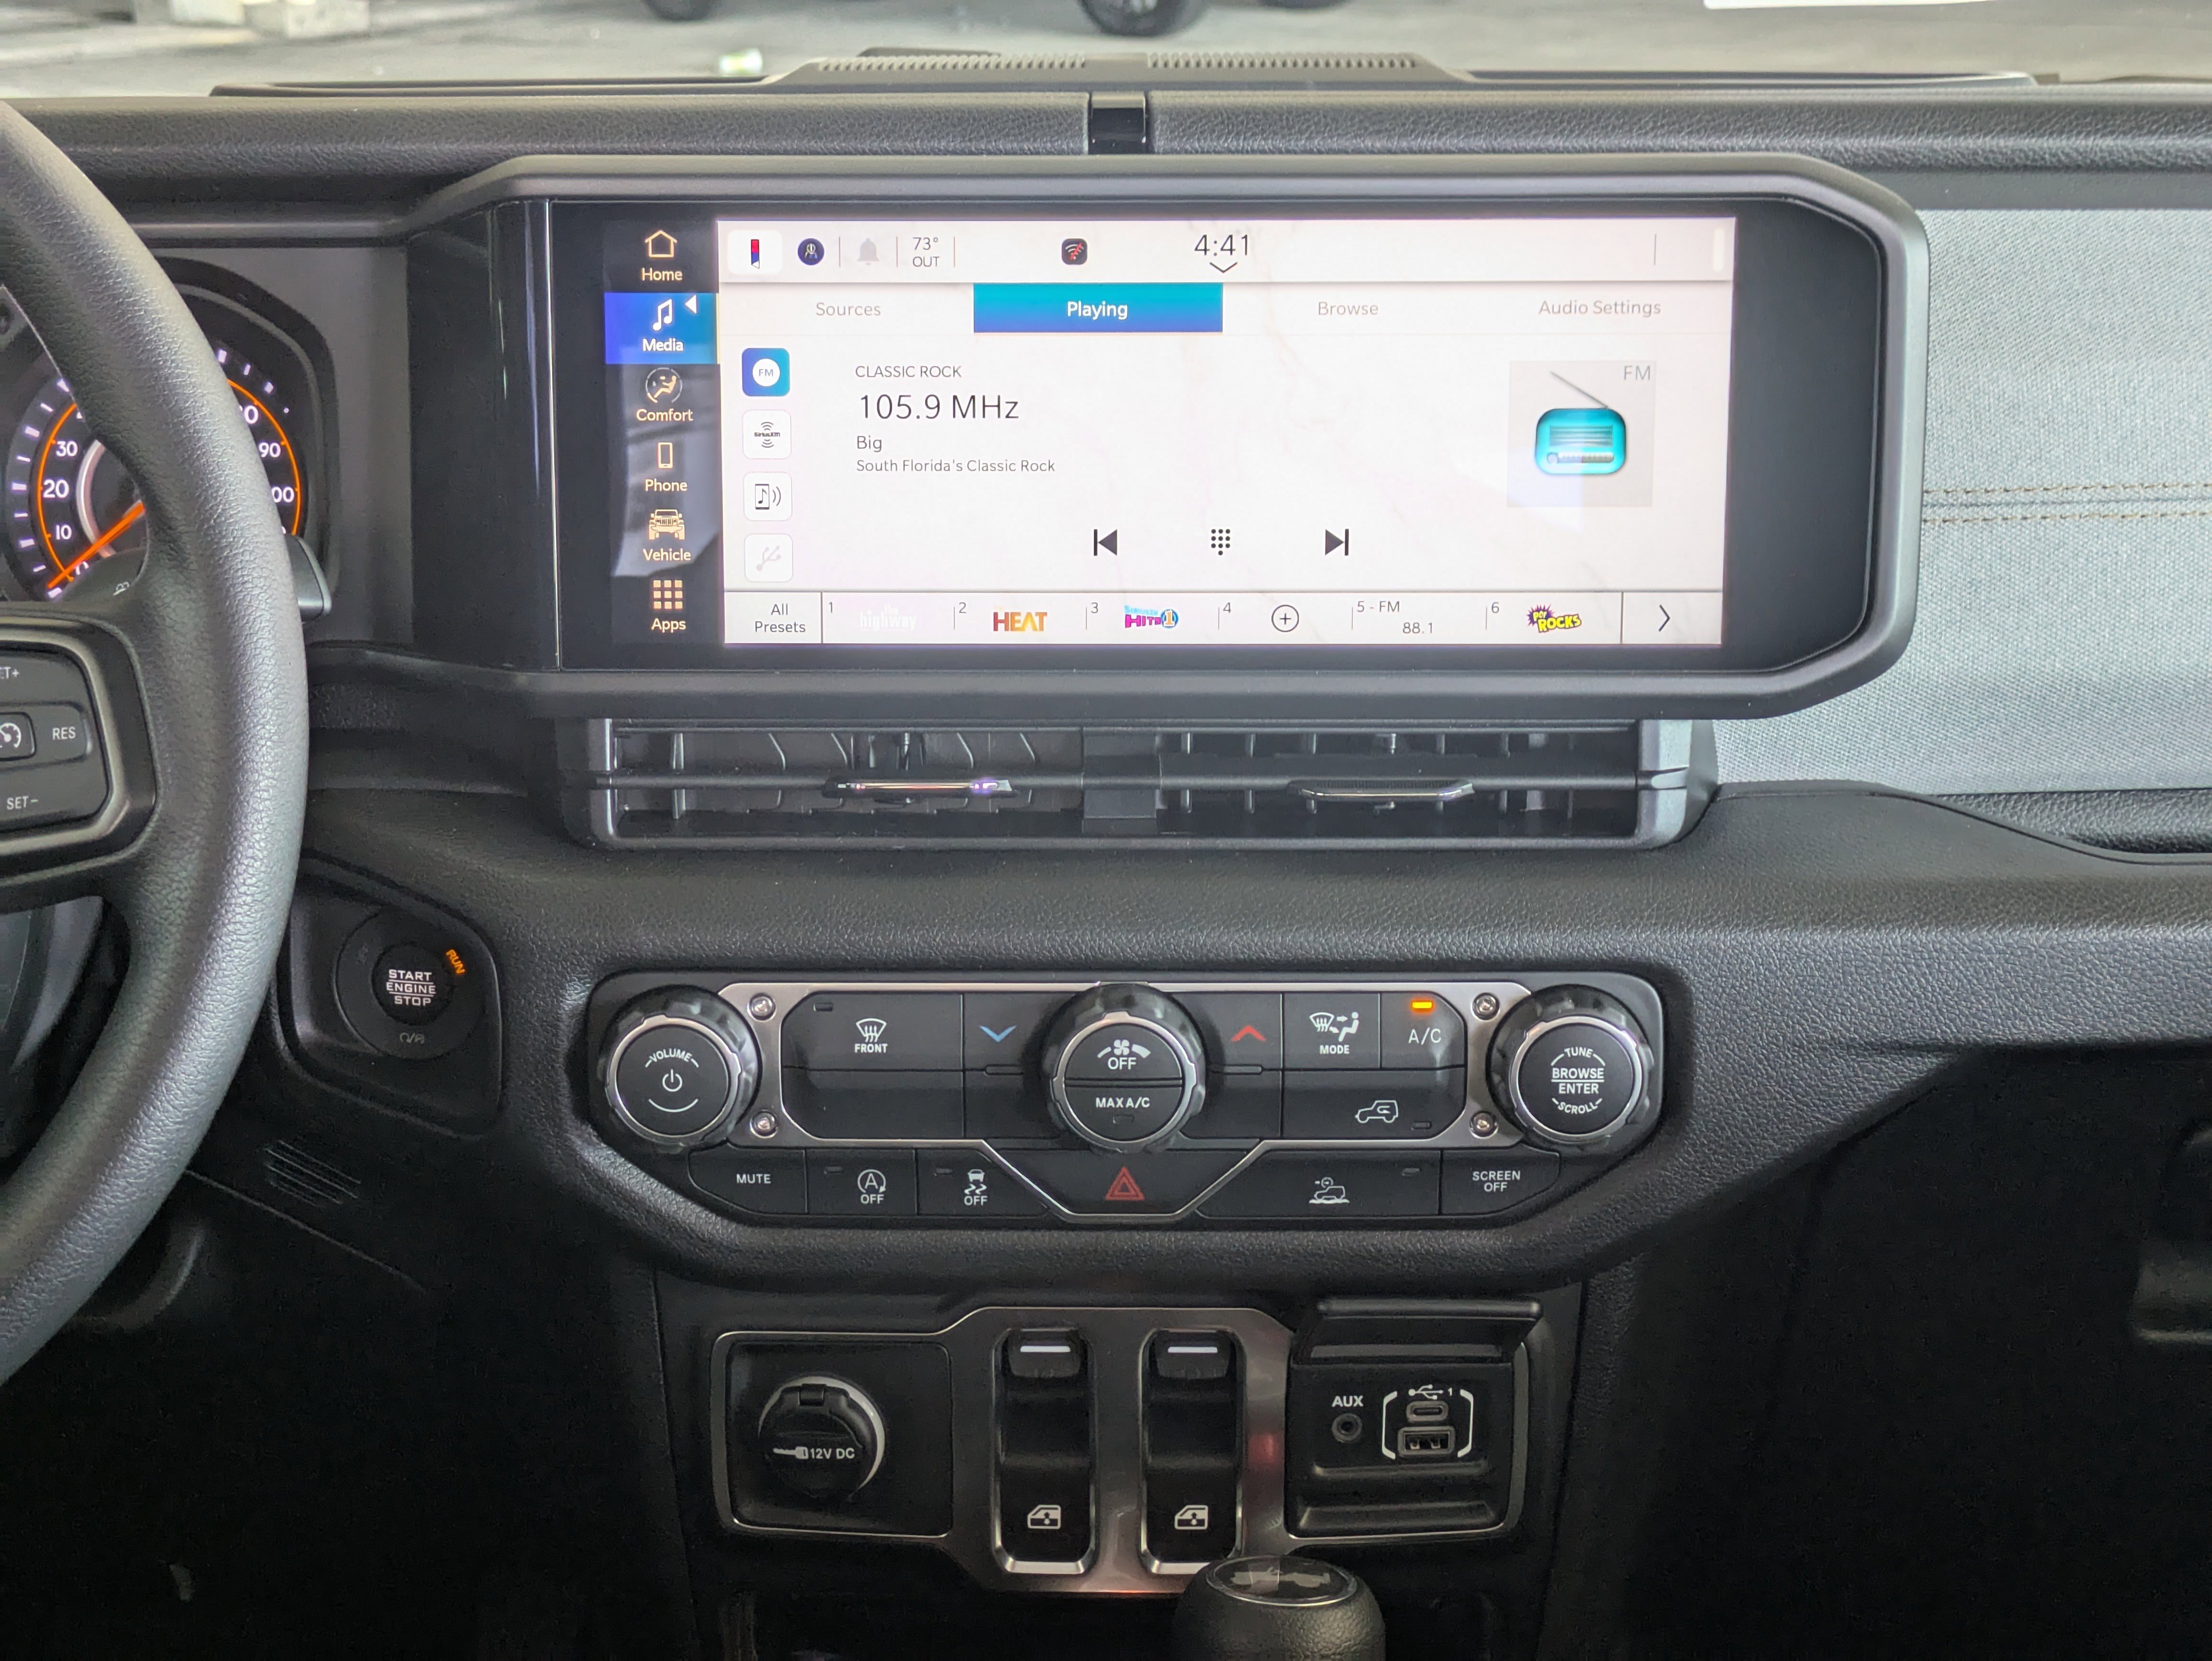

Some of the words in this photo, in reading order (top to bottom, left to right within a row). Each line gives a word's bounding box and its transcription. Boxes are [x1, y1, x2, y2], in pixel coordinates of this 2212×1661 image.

[913, 237, 939, 250] 73°
[1194, 234, 1250, 256] 4:41
[912, 256, 940, 267] OUT
[641, 267, 683, 281] Home
[816, 302, 881, 316] Sources
[1067, 301, 1128, 320] Playing
[1318, 301, 1378, 316] Browse
[1538, 300, 1588, 315] Audio
[1593, 300, 1661, 318] Settings
[642, 338, 684, 352] Media
[759, 368, 774, 376] FM
[855, 365, 915, 377] CLASSIC
[920, 365, 962, 377] ROCK
[1624, 365, 1651, 380] FM
[861, 394, 940, 419] 105.9
[952, 395, 1019, 419] MHz
[635, 408, 694, 422] Comfort
[55, 441, 78, 456] 30
[258, 442, 281, 457] 90
[857, 435, 883, 453] Big
[857, 459, 897, 472] South
[903, 459, 963, 472] Florida's
[967, 459, 1016, 472] Classic
[1021, 460, 1055, 472] Rock
[43, 479, 69, 498] 20
[645, 479, 687, 492] Phone
[271, 486, 295, 503] 00
[55, 524, 72, 540] 10
[642, 548, 691, 562] Vehicle
[771, 603, 788, 615] All
[829, 601, 833, 613] 1
[959, 602, 966, 614] 2
[1091, 602, 1098, 614] 3
[1223, 602, 1231, 613] 4
[1357, 600, 1365, 612] 5
[1379, 600, 1400, 612] FM
[1491, 602, 1500, 613] 6
[651, 618, 686, 633] Apps
[755, 621, 806, 633] Presets
[993, 612, 1048, 632] HEAT
[1403, 621, 1433, 634] 88.1
[1537, 614, 1582, 632] ROCKS
[52, 726, 76, 740] RES
[446, 949, 465, 974] RUN
[388, 969, 432, 981] START
[386, 982, 436, 994] ENGINE
[394, 996, 431, 1006] STOP
[1408, 1028, 1441, 1044] A/C
[854, 1043, 888, 1053] FRONT
[1319, 1044, 1350, 1054] MODE
[1564, 1047, 1593, 1058] TUNE
[650, 1048, 692, 1062] VOLUME
[1107, 1057, 1137, 1070] OFF
[1552, 1068, 1604, 1079] BROWSE
[1559, 1083, 1599, 1094] ENTER
[1095, 1097, 1124, 1108] MAX
[1126, 1096, 1150, 1108] A/C
[1558, 1101, 1598, 1115] SCROLL
[736, 1174, 771, 1184] MUTE
[1472, 1171, 1521, 1181] SCREEN
[1484, 1182, 1508, 1192] OFF
[861, 1194, 885, 1204] OFF
[964, 1195, 988, 1206] OFF
[1331, 1395, 1363, 1407] AUX
[810, 1448, 832, 1459] 12V
[836, 1447, 855, 1459] DC
